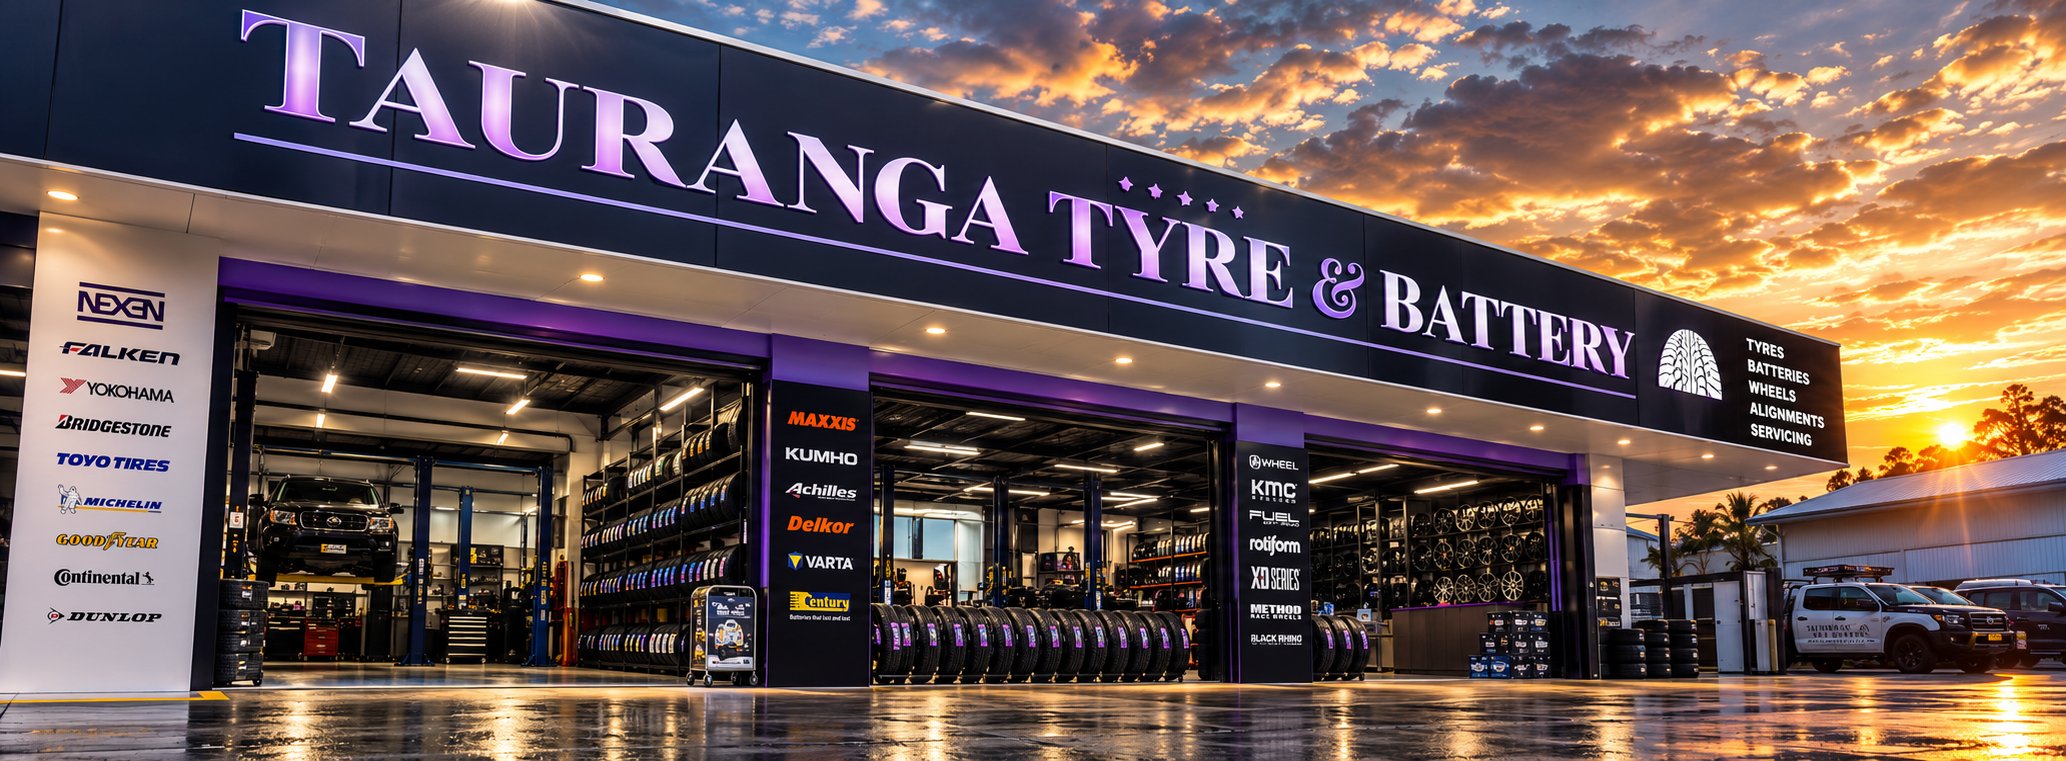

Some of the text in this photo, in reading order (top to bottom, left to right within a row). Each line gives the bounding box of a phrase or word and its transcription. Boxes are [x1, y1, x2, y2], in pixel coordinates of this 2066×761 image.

[241, 9, 1635, 379] TAURANGA TYRE & BATTERY
[78, 290, 165, 322] NEXEN
[60, 341, 180, 365] FALKEN
[1746, 338, 1784, 359] TYRES
[1747, 359, 1810, 385] BATTERIES
[87, 381, 174, 403] YOKOHAMA
[1748, 380, 1796, 402] WHEELS
[55, 414, 172, 437] BRIDGESTONE
[787, 410, 857, 431] MAXXIS
[1750, 402, 1825, 429] ALIGNMENTS
[1750, 423, 1812, 446] SERVICING
[57, 452, 170, 472] TOYO TIRES
[785, 447, 858, 466] KUMHO
[1261, 458, 1299, 471] WHEEL
[785, 482, 857, 498] Achilles
[84, 497, 162, 510] MICHELIN
[787, 515, 855, 534] Delkor
[1249, 509, 1300, 523] FUEL
[56, 532, 158, 550] GOODYEAR
[1249, 535, 1301, 557] rotiform
[805, 555, 854, 570] VARTA
[54, 569, 140, 586] Continental
[1270, 567, 1300, 591] SERIES
[804, 596, 850, 612] Century
[1250, 604, 1302, 615] METHOD
[67, 612, 162, 623] DUNLOP
